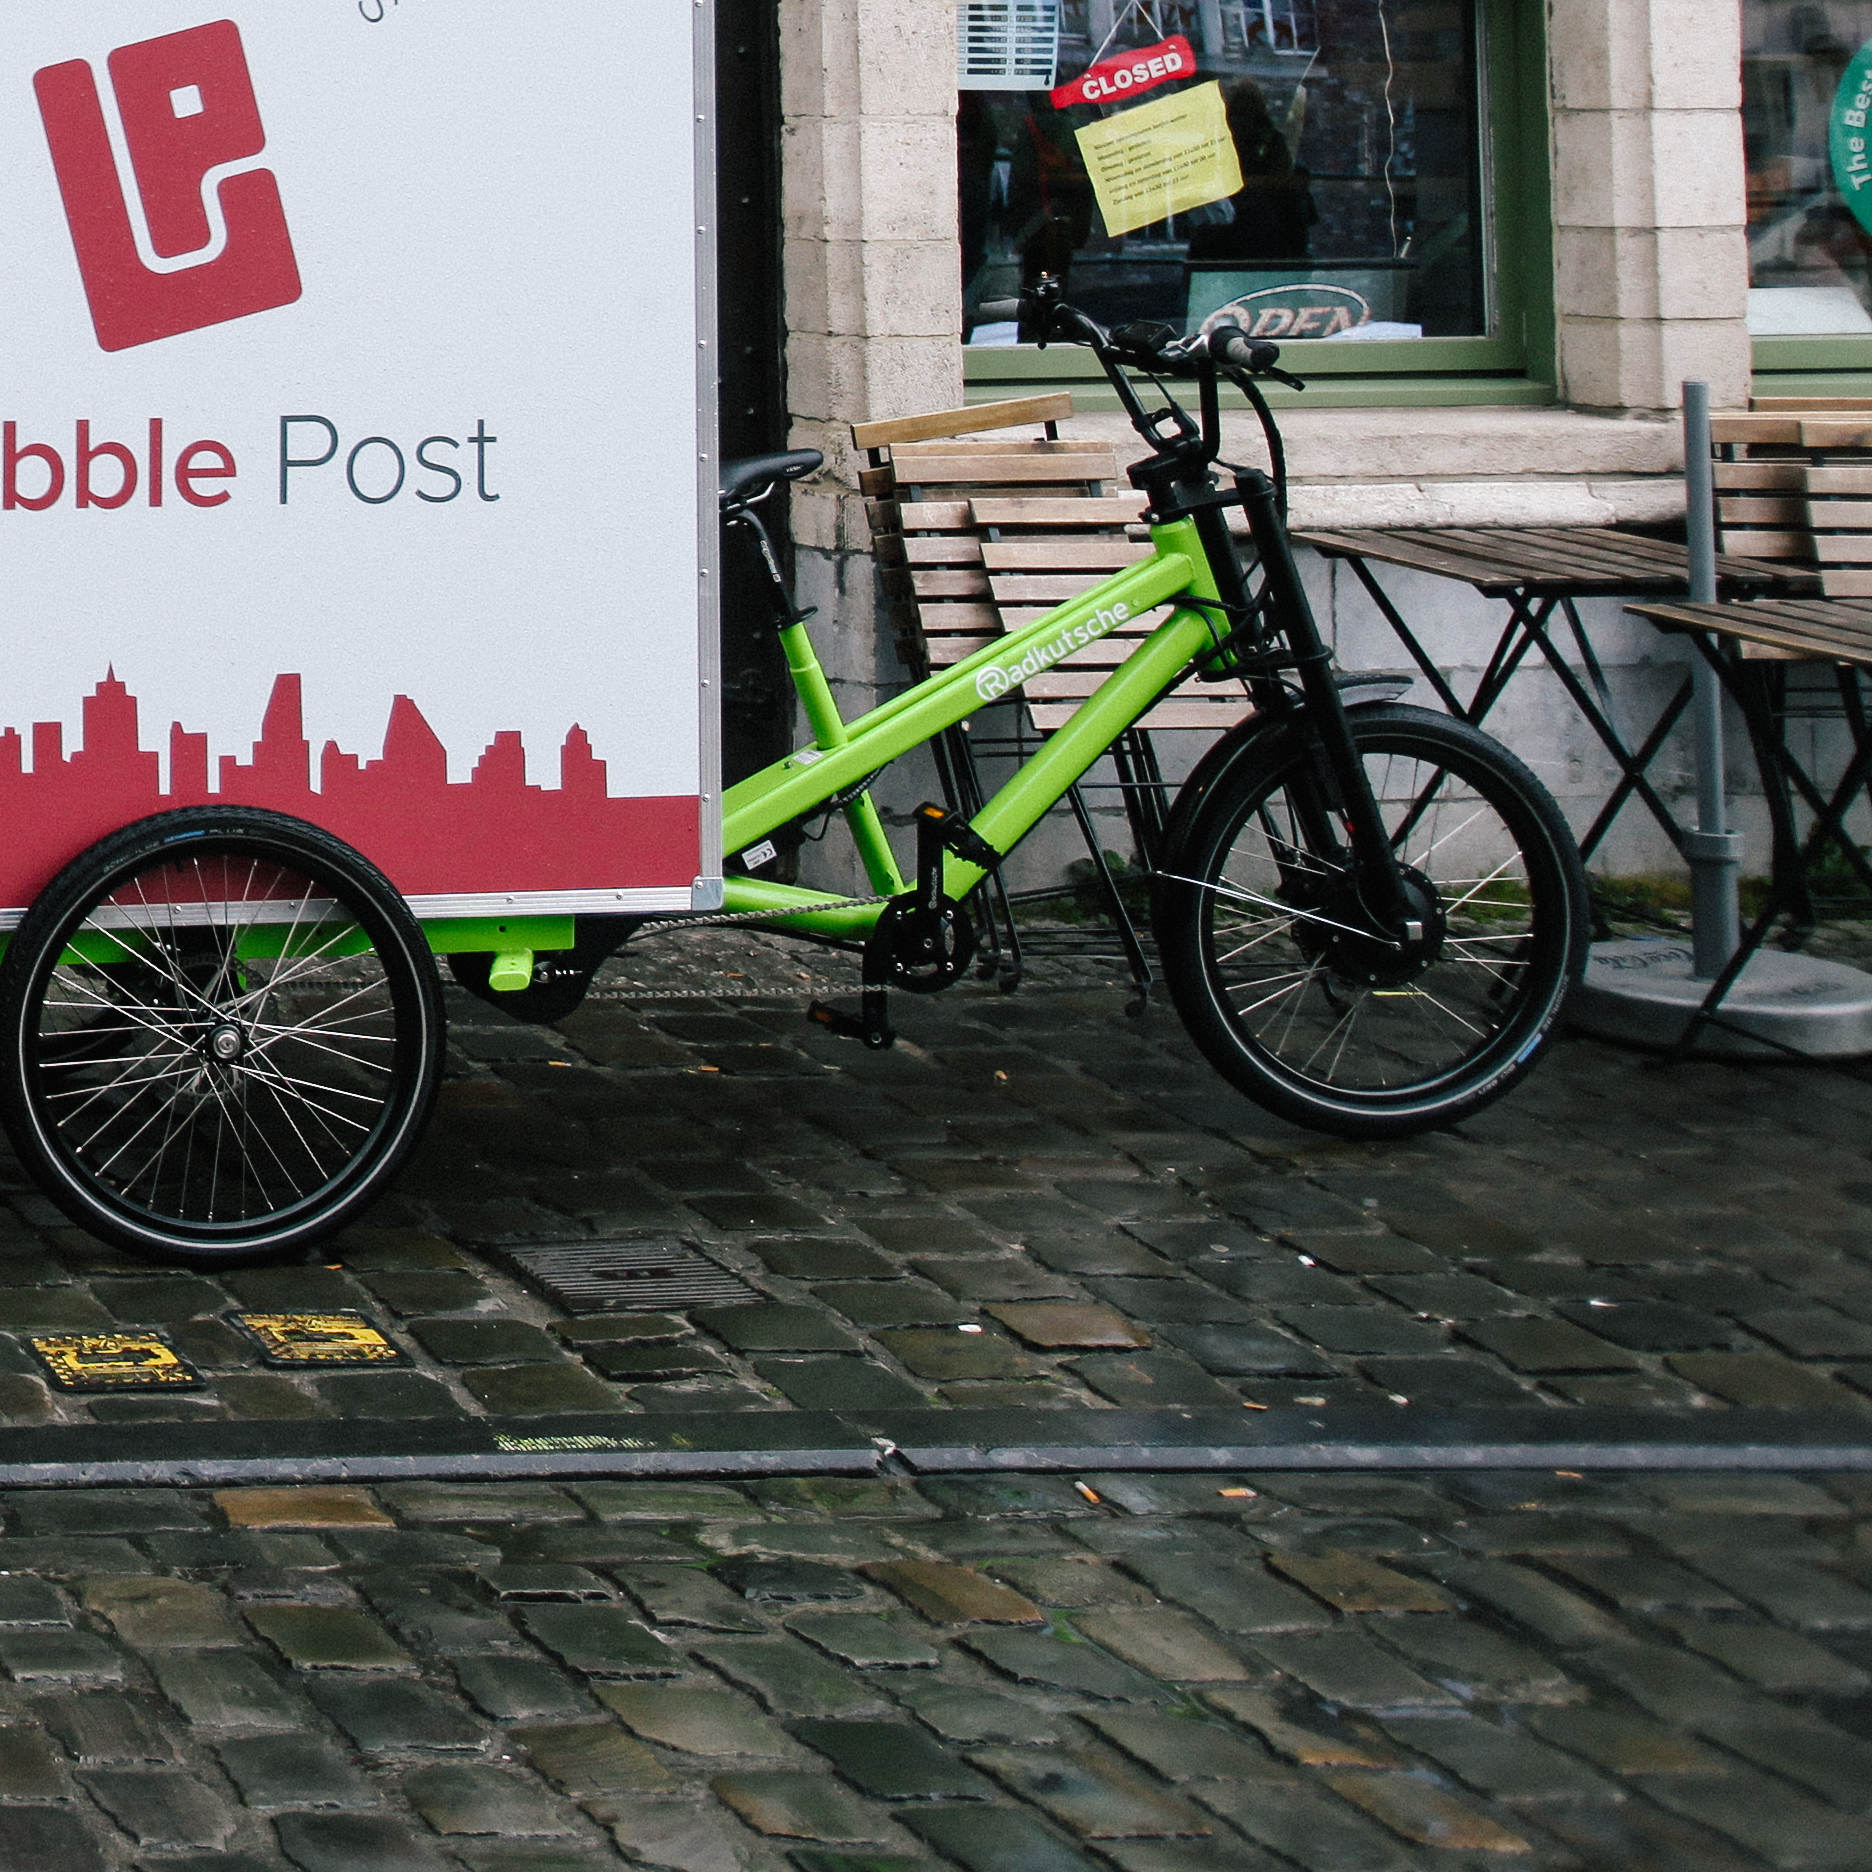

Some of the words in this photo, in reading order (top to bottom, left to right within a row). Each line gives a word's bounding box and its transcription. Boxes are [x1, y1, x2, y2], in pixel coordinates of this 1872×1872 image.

[1082, 51, 1183, 100] CLOSED
[1846, 136, 1872, 191] The
[278, 414, 501, 506] Post
